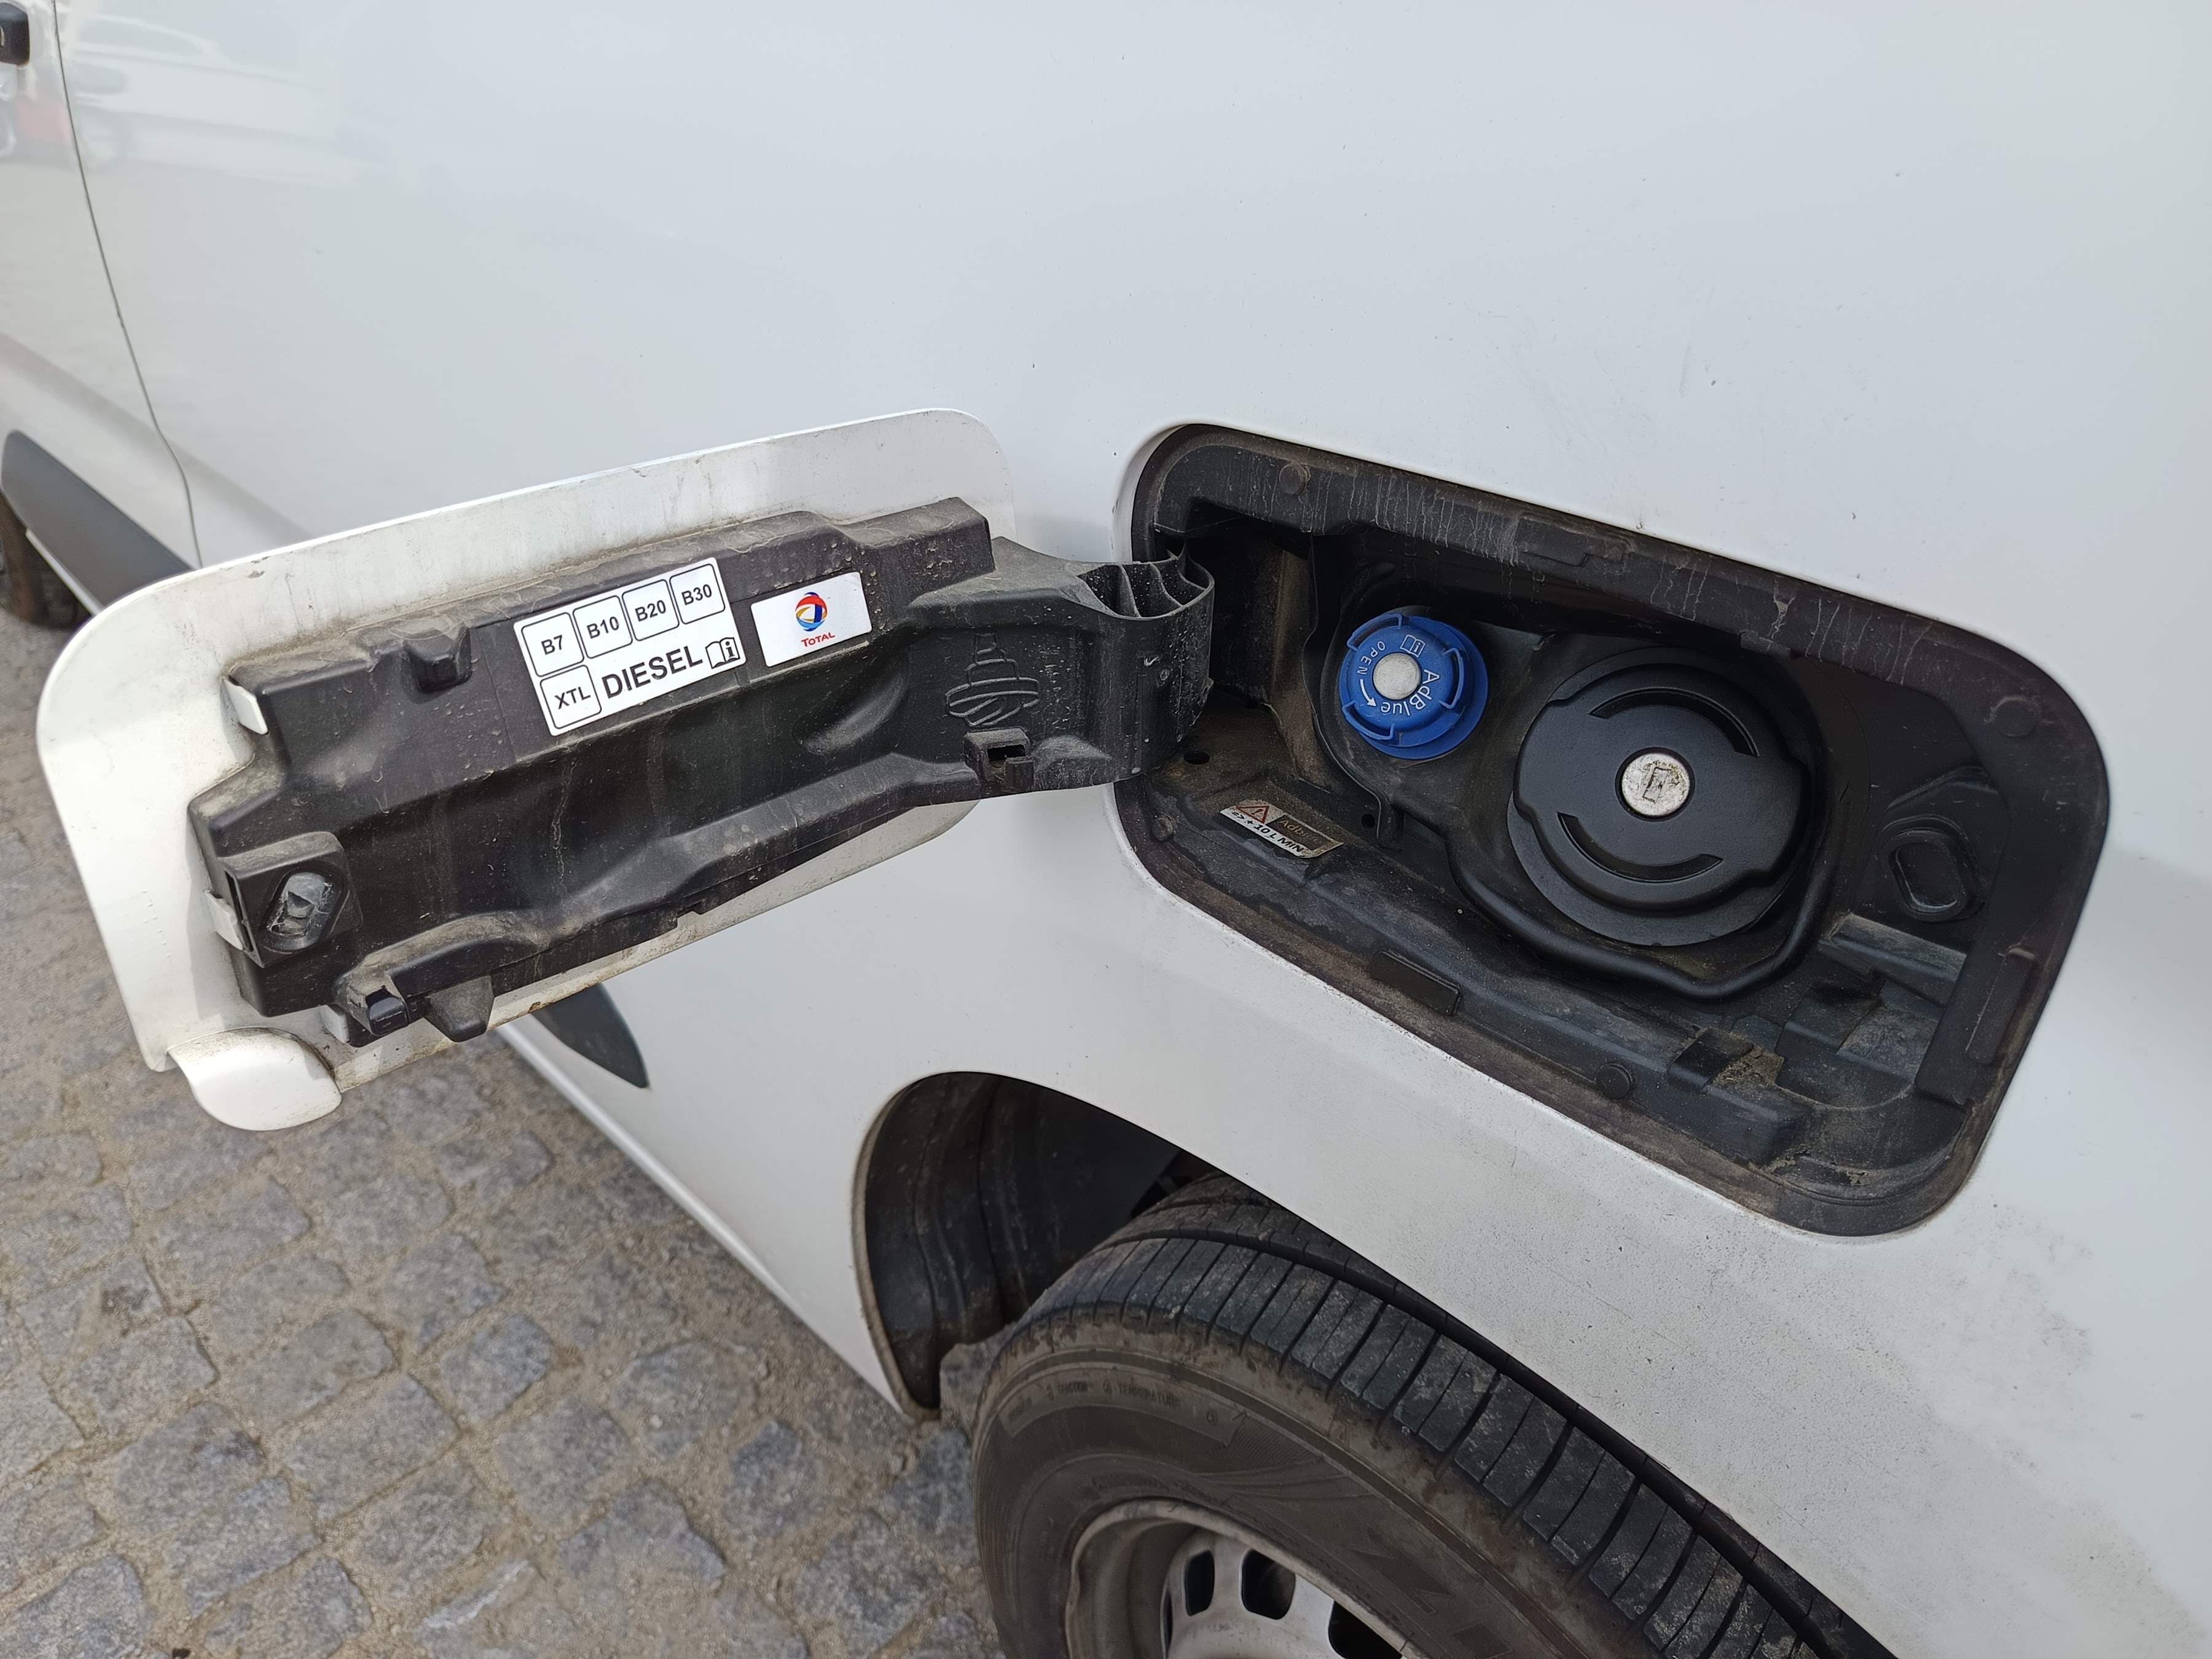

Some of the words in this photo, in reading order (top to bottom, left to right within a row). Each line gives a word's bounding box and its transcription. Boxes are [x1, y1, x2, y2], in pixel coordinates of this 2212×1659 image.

[541, 635, 562, 655] B7
[587, 616, 619, 639] B10
[635, 600, 666, 622] B20
[681, 584, 712, 606] B30
[801, 632, 836, 647] TOTAL
[602, 646, 703, 699] DIESEL
[1357, 641, 1386, 675] OPEN
[554, 686, 591, 710] XTL
[1380, 669, 1440, 716] AdBlue
[1253, 823, 1267, 834] 10
[1269, 830, 1278, 839] L
[1277, 837, 1305, 853] MIN
[1278, 818, 1317, 842] Adbl
